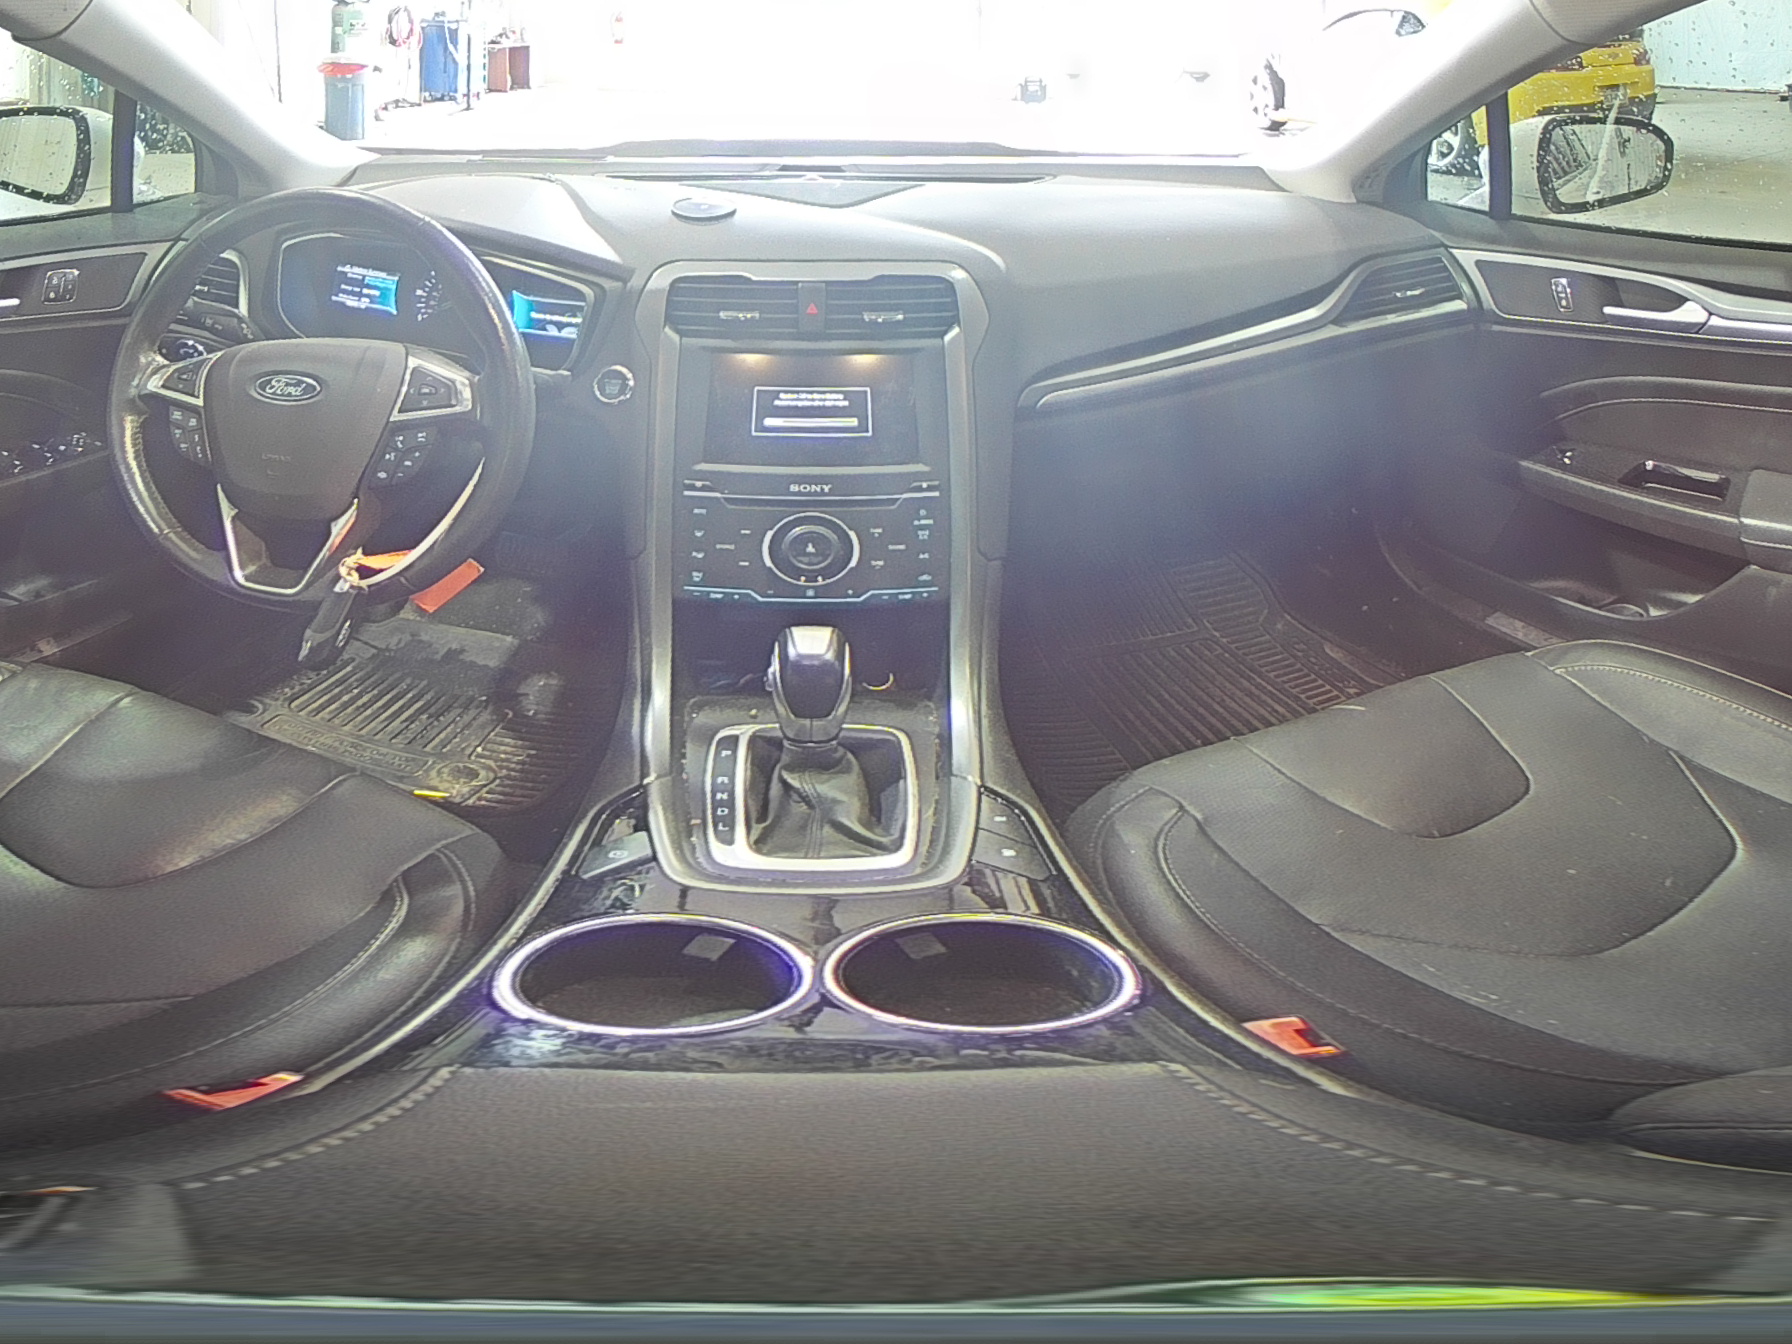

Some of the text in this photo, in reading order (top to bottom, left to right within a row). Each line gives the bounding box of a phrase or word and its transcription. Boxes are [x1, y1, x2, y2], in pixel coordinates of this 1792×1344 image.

[265, 377, 307, 396] Ford
[789, 483, 832, 493] SONY
[720, 749, 732, 757] P
[715, 792, 729, 800] N
[716, 807, 729, 816] D
[718, 822, 729, 831] L
